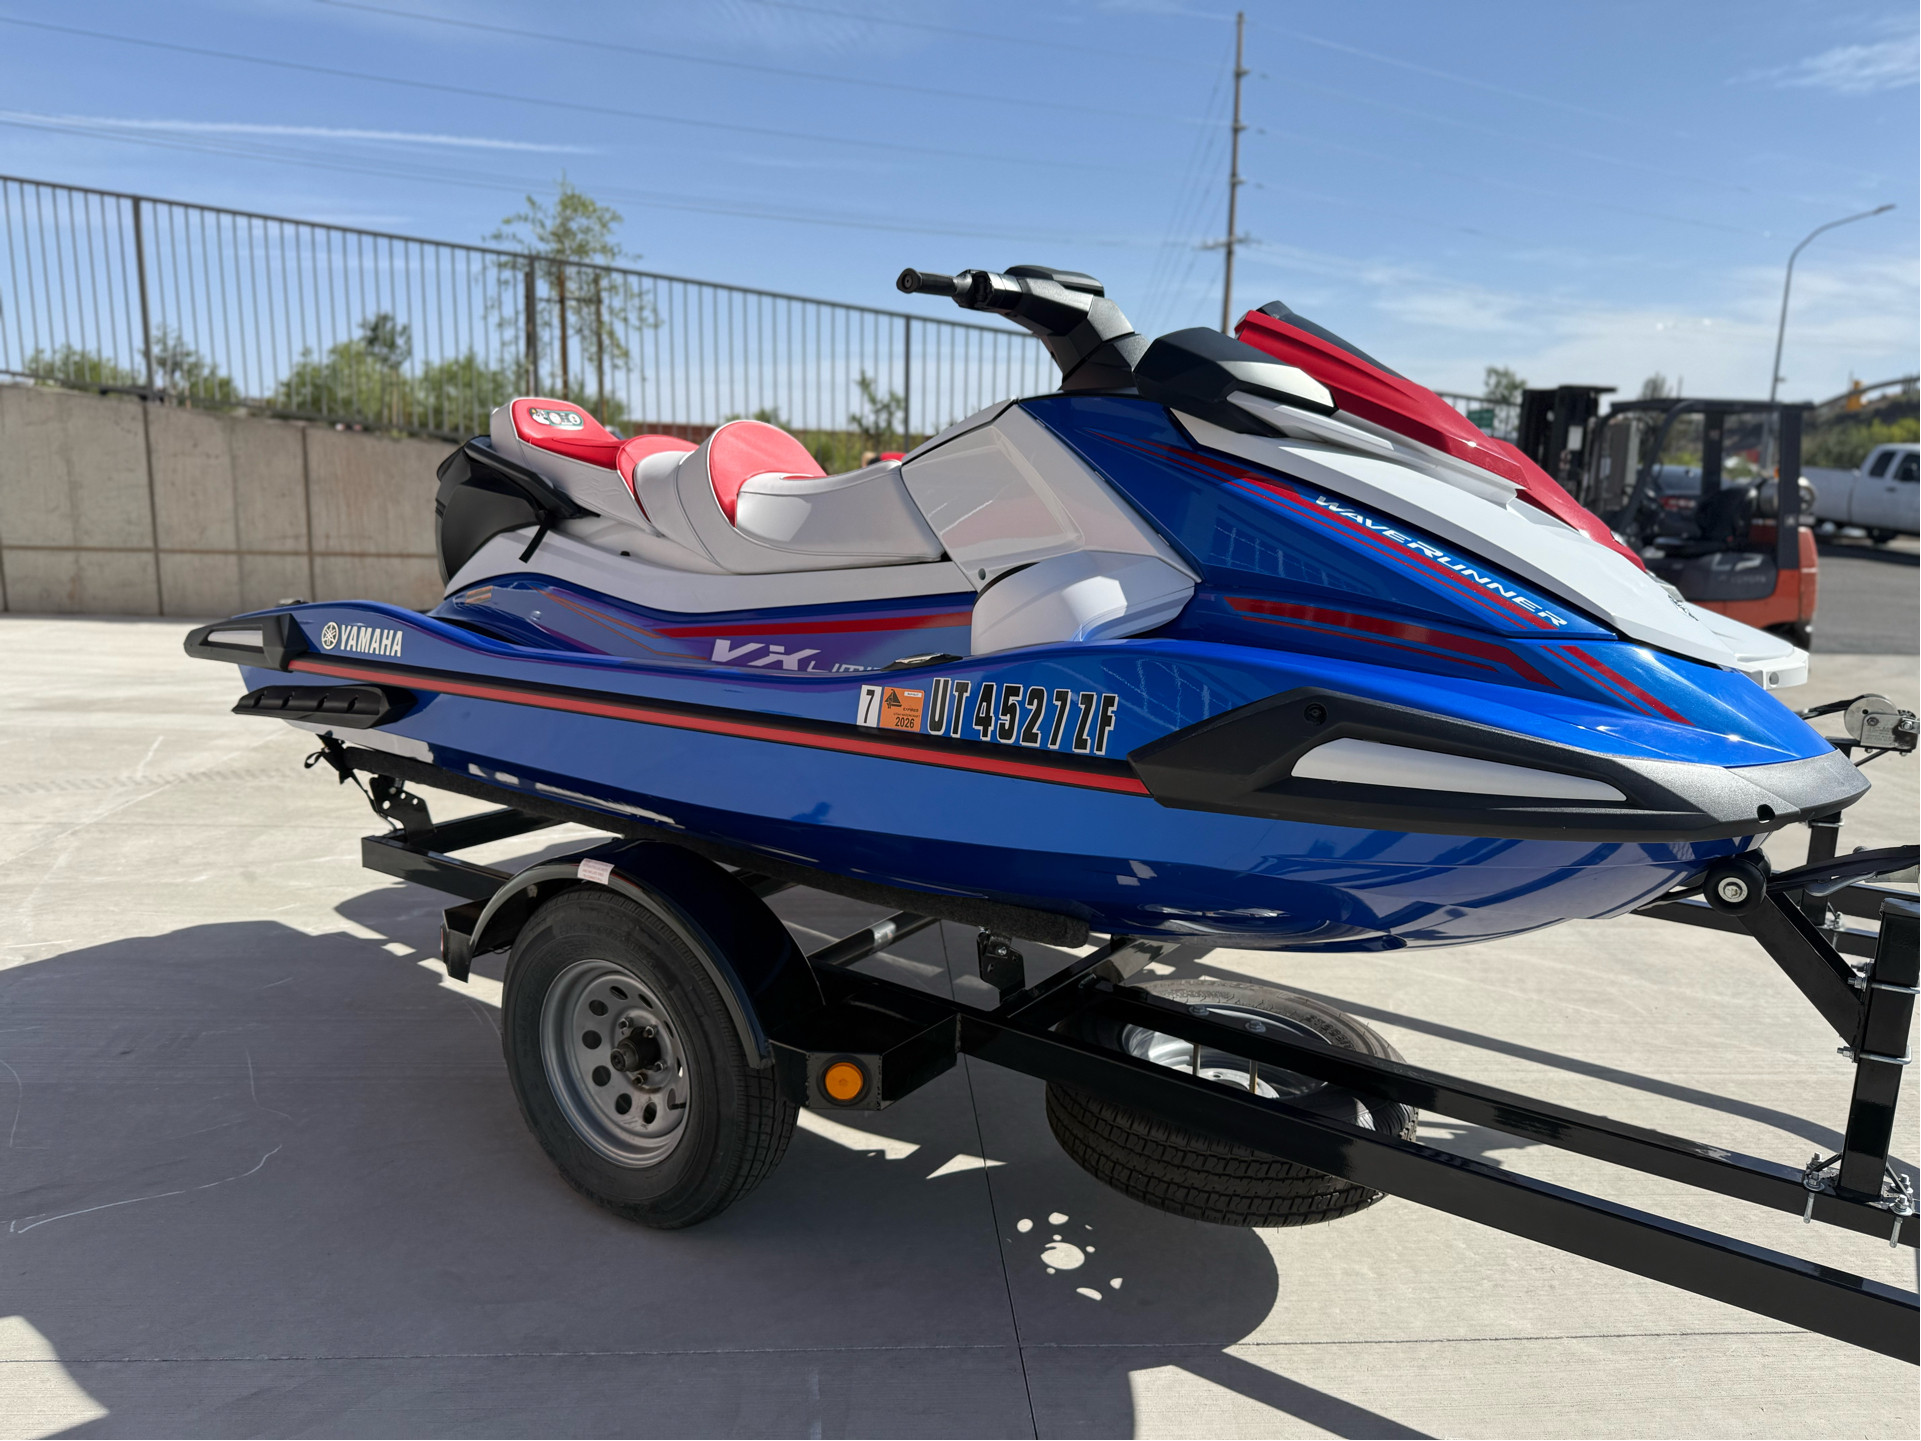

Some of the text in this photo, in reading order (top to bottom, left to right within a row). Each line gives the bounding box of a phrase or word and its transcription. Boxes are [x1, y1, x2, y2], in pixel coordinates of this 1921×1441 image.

[1316, 496, 1568, 627] WAVERUNNER
[340, 624, 403, 657] YAMAHA
[711, 639, 881, 673] VX LIM
[863, 689, 876, 724] 7
[895, 716, 915, 729] 2026
